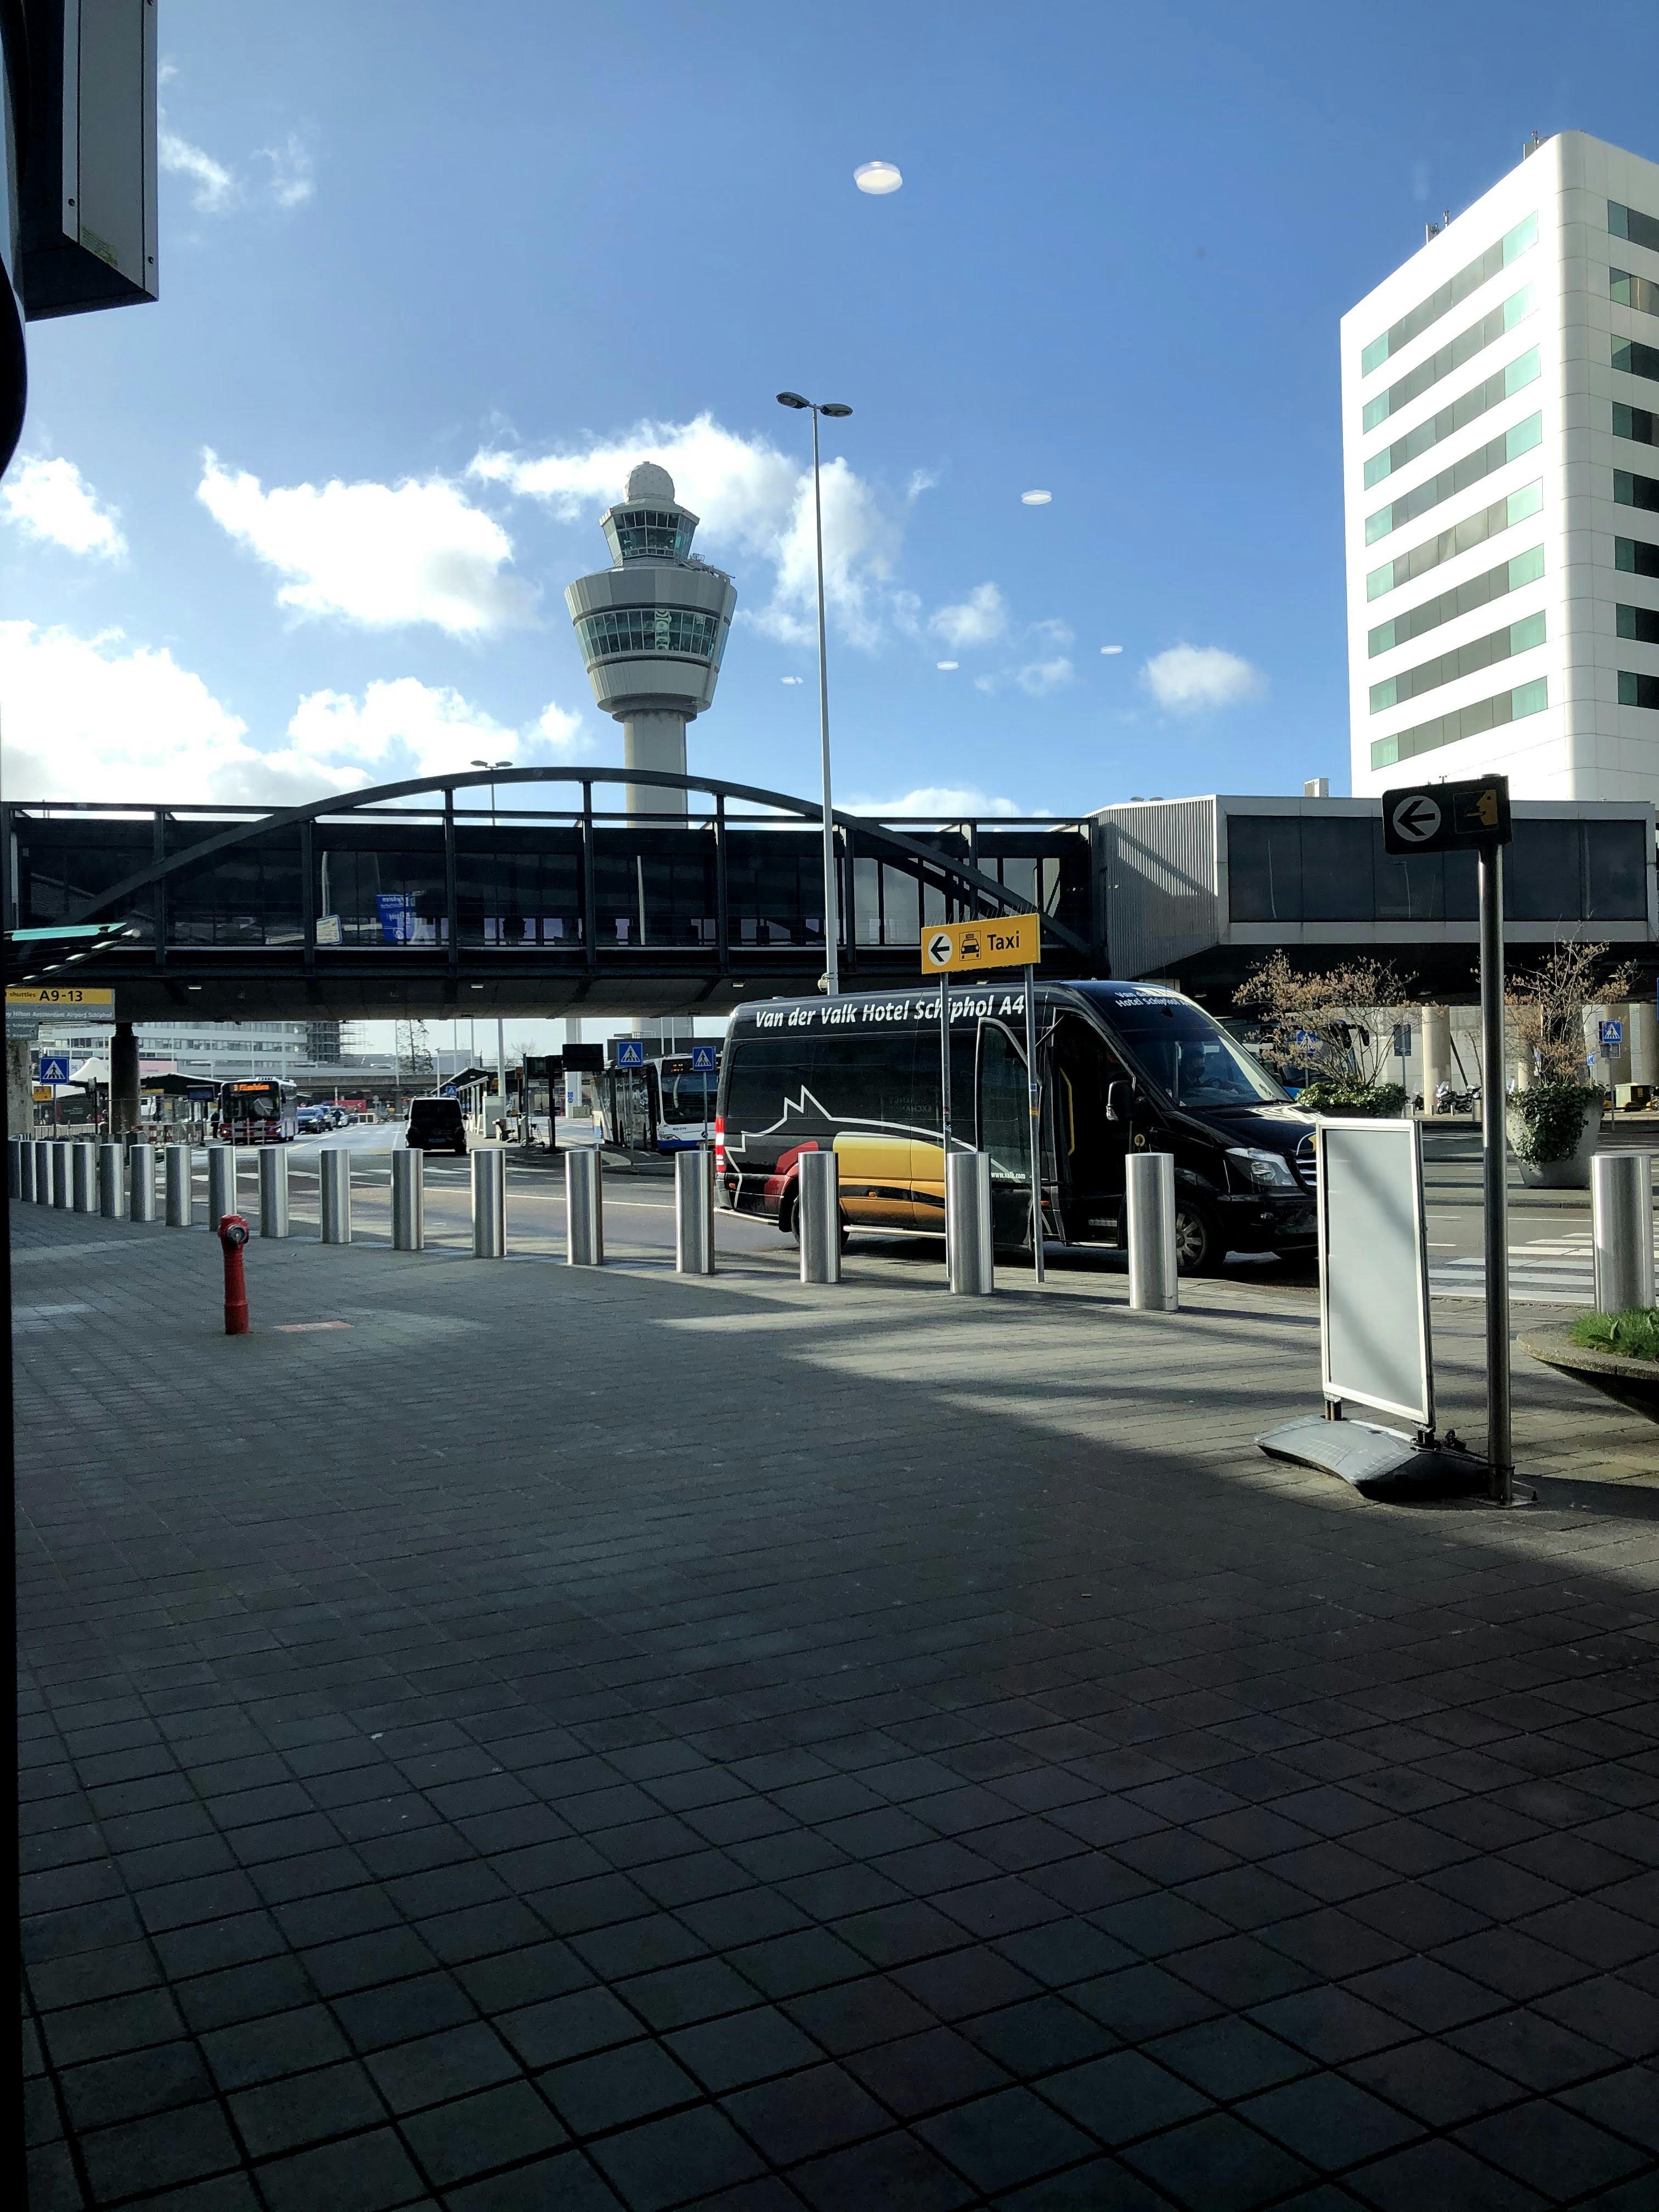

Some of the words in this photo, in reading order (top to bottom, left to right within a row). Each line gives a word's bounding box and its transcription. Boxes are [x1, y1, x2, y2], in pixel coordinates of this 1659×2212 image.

[987, 930, 1019, 951] Taxi
[39, 990, 83, 1002] A9-13
[1115, 998, 1144, 1007] Hotel
[756, 1011, 784, 1028] Van
[788, 1007, 816, 1026] der
[821, 1004, 858, 1024] Valk
[862, 1000, 910, 1022] Hotel
[913, 995, 995, 1023] Schiphol
[998, 995, 1025, 1015] A4
